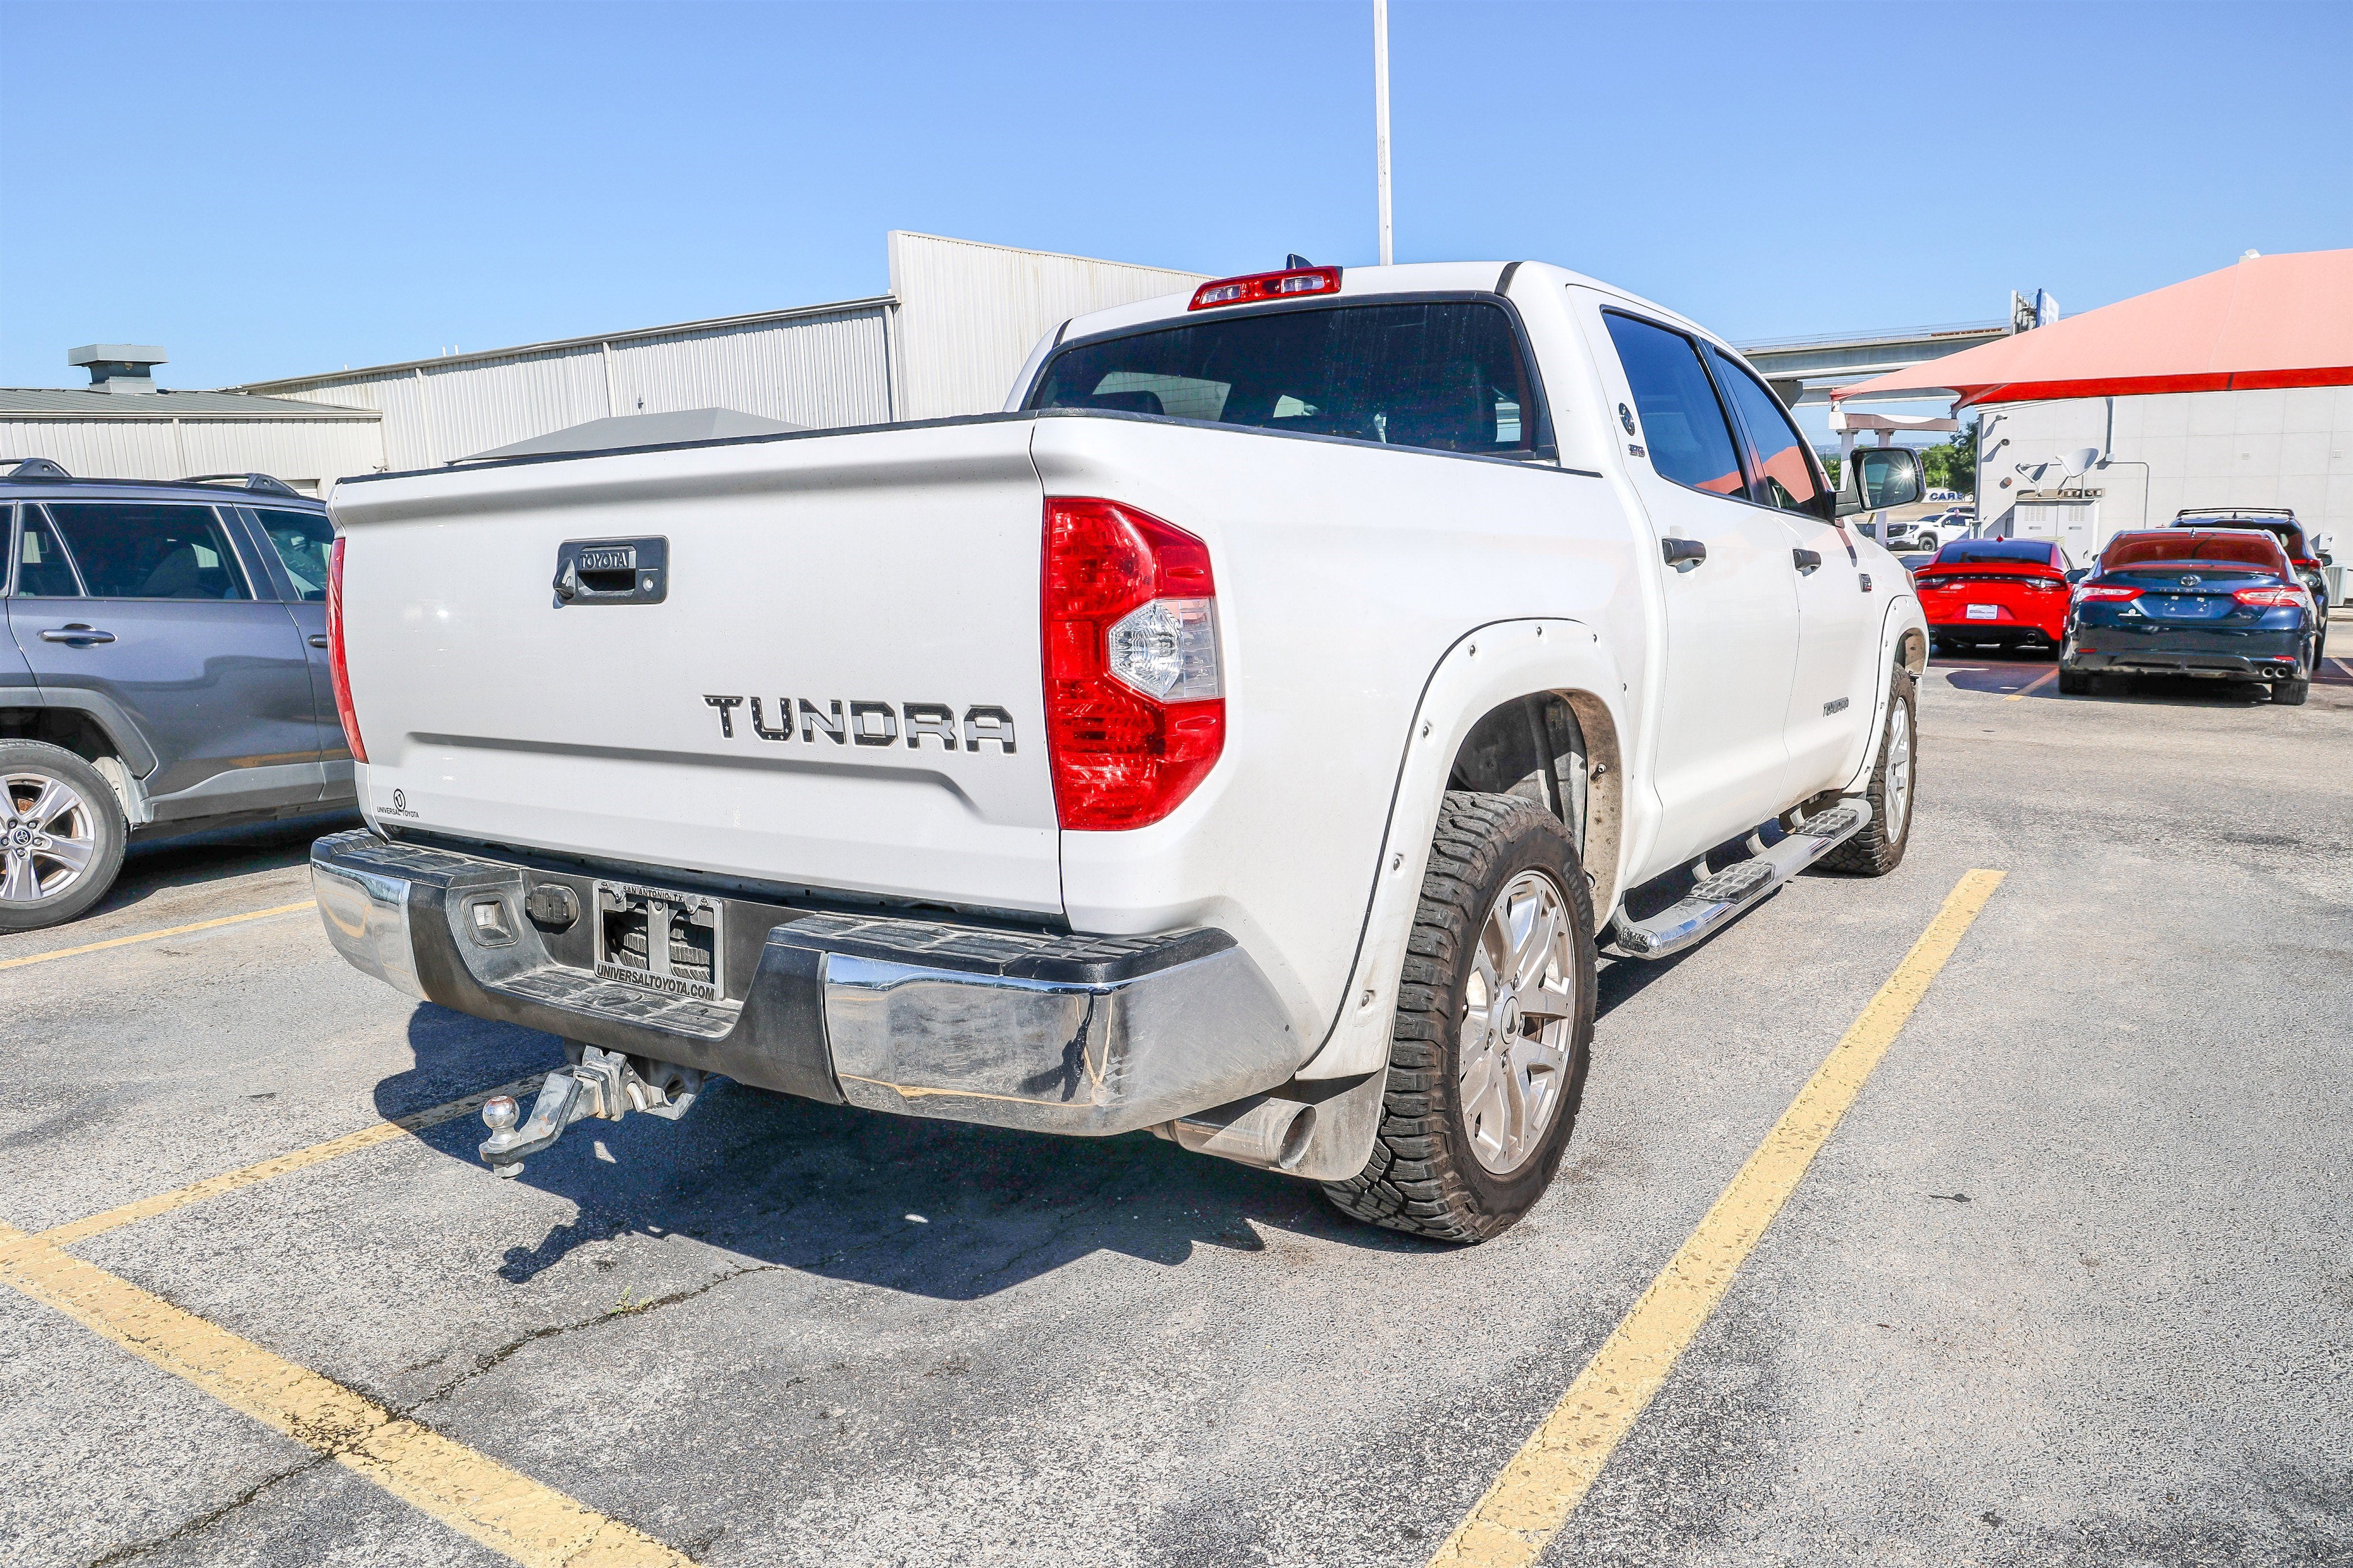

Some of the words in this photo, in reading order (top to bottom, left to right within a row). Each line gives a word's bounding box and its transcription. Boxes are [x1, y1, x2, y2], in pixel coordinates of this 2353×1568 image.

[580, 552, 627, 569] TOYOTA
[702, 694, 1016, 755] TUNDRA
[376, 806, 401, 816] UNIVERSAL
[402, 809, 419, 818] TOYOTA
[623, 886, 637, 894] SAN
[673, 893, 684, 902] TX
[597, 963, 715, 1000] UNIVERSALTOYOTA.COM
